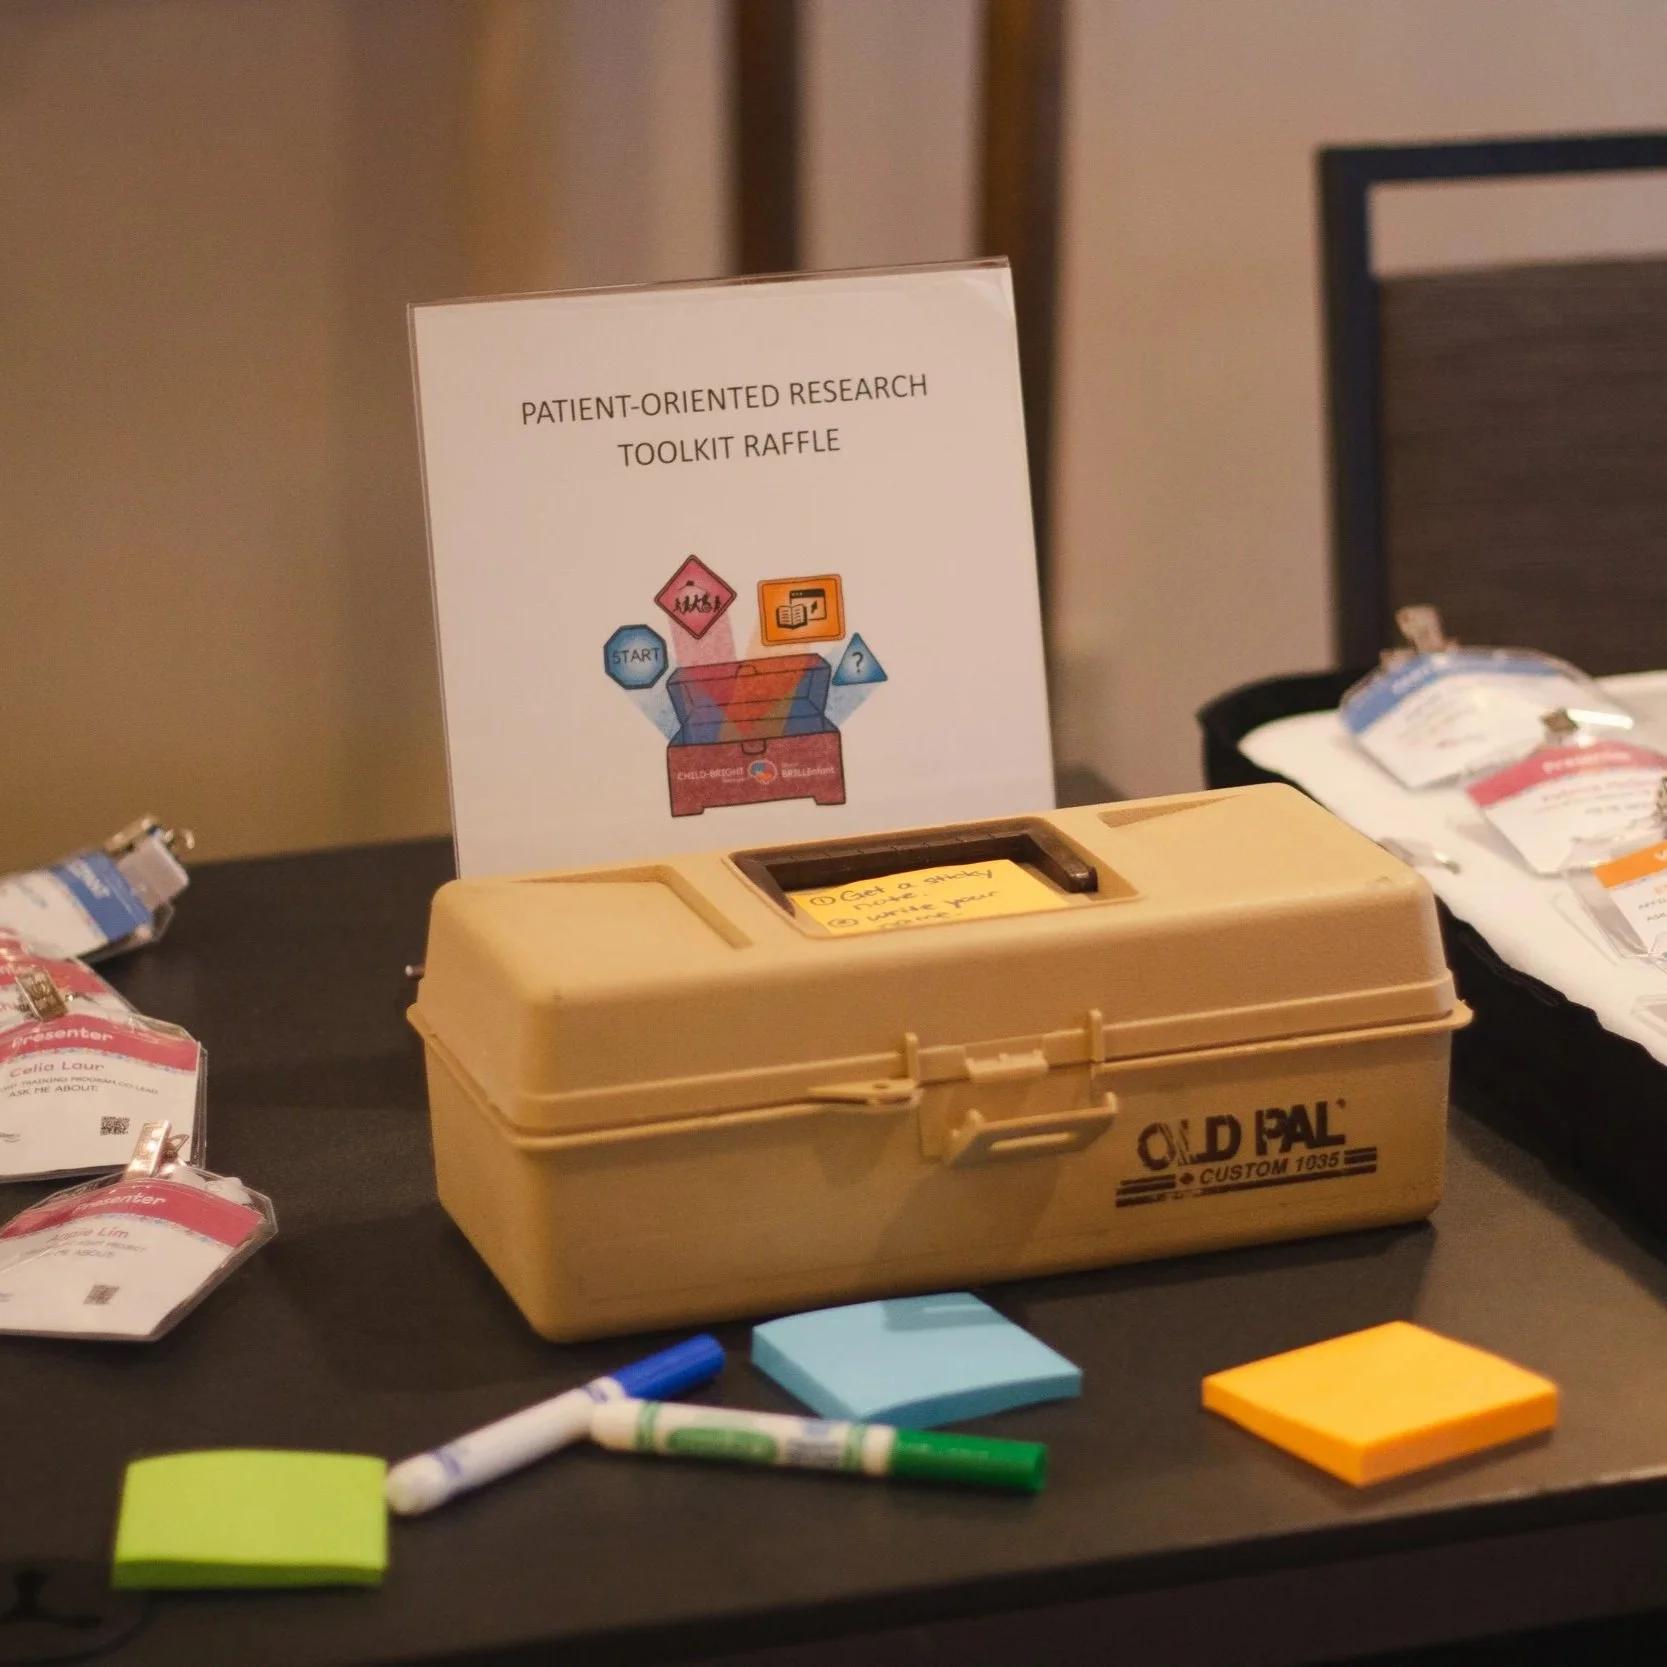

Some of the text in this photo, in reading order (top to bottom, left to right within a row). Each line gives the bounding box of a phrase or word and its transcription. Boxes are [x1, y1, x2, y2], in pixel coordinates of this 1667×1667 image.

[521, 373, 928, 425] PATIENT-ORIENTED RESEARCH
[617, 428, 841, 467] TOOLKIT RAFFLE
[611, 647, 660, 665] START
[840, 886, 885, 902] Get
[897, 882, 914, 890] a
[923, 869, 993, 885] sticky
[944, 890, 999, 909] your
[9, 1062, 55, 1078] Celia
[8, 1088, 31, 1098] ASK
[34, 1085, 50, 1095] ME
[1137, 1100, 1347, 1171] OLD PAL
[1199, 1151, 1341, 1186] CUSTOM 1035
[97, 1226, 129, 1239] Lim
